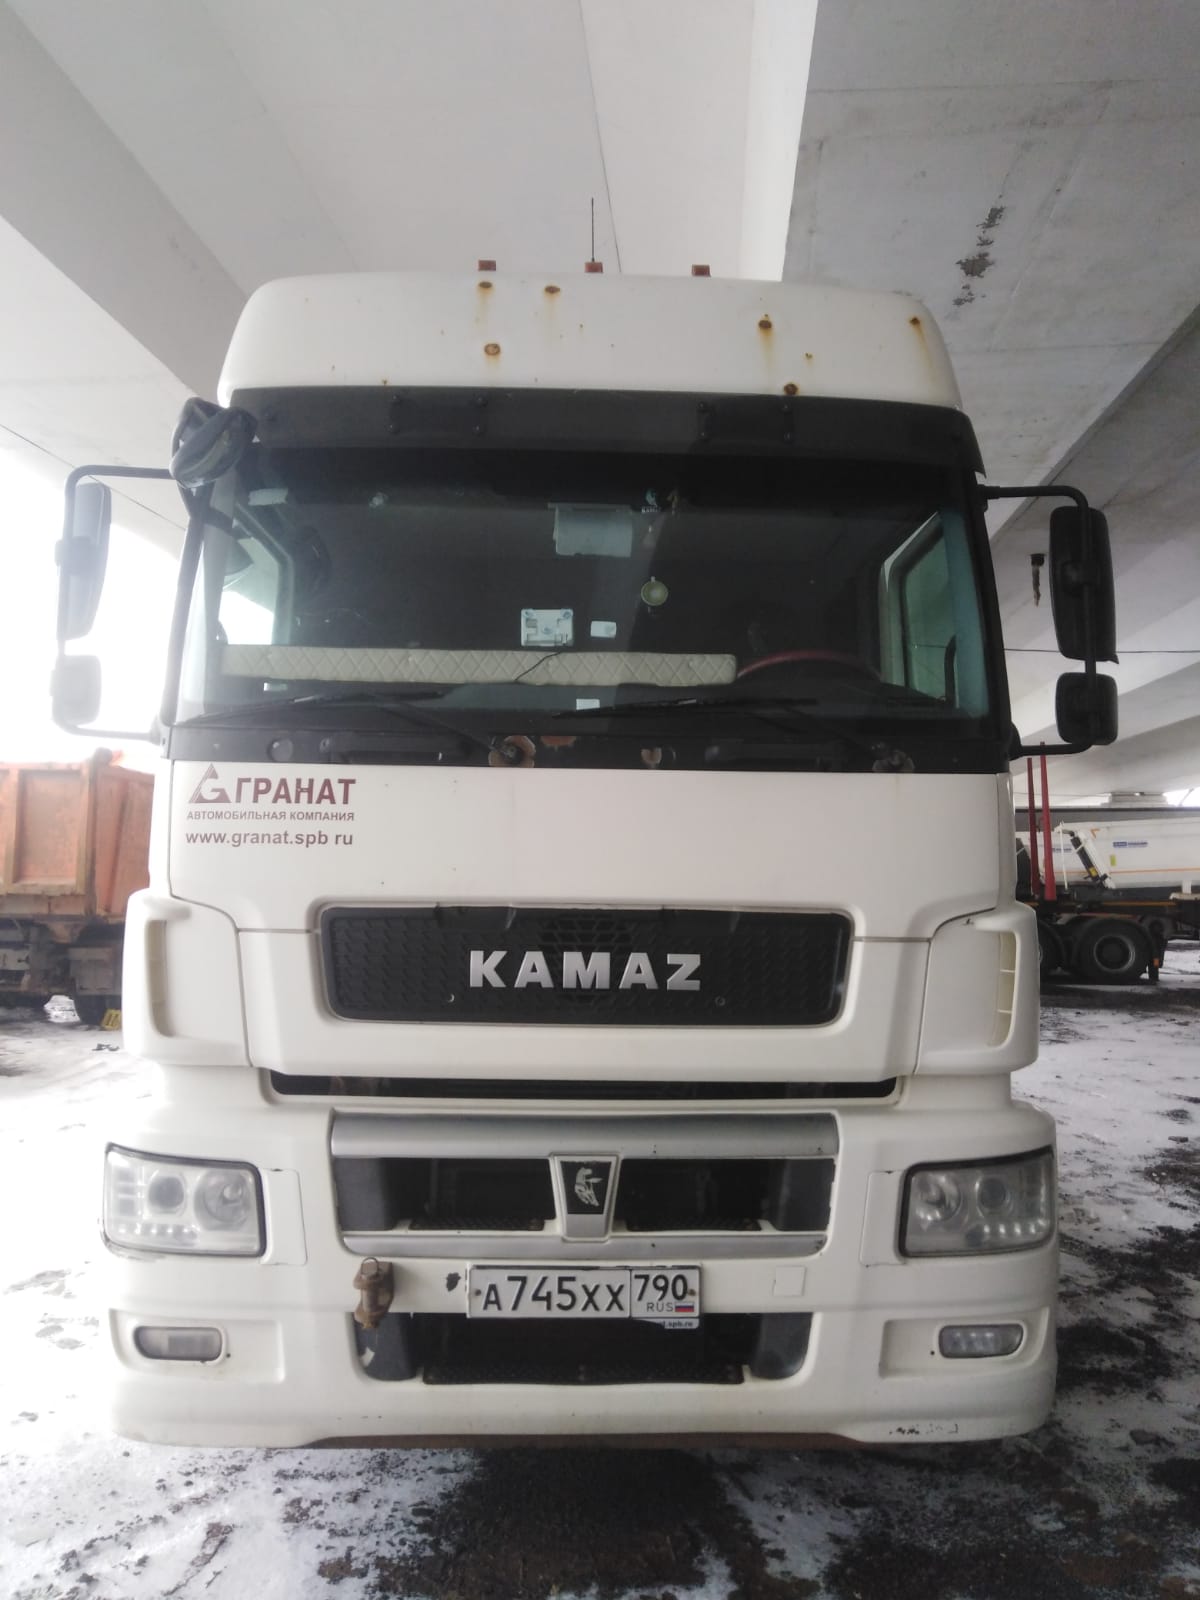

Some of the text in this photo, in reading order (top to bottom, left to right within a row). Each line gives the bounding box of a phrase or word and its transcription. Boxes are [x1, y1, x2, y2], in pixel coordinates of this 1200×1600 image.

[236, 777, 356, 805] ГРАНАТ
[187, 811, 355, 821] АВТОМОБИЛЬНАЯ КОМПАНИЯ
[469, 950, 701, 991] KAMAZ
[634, 1274, 688, 1301] 790
[646, 1302, 674, 1312] RUS
